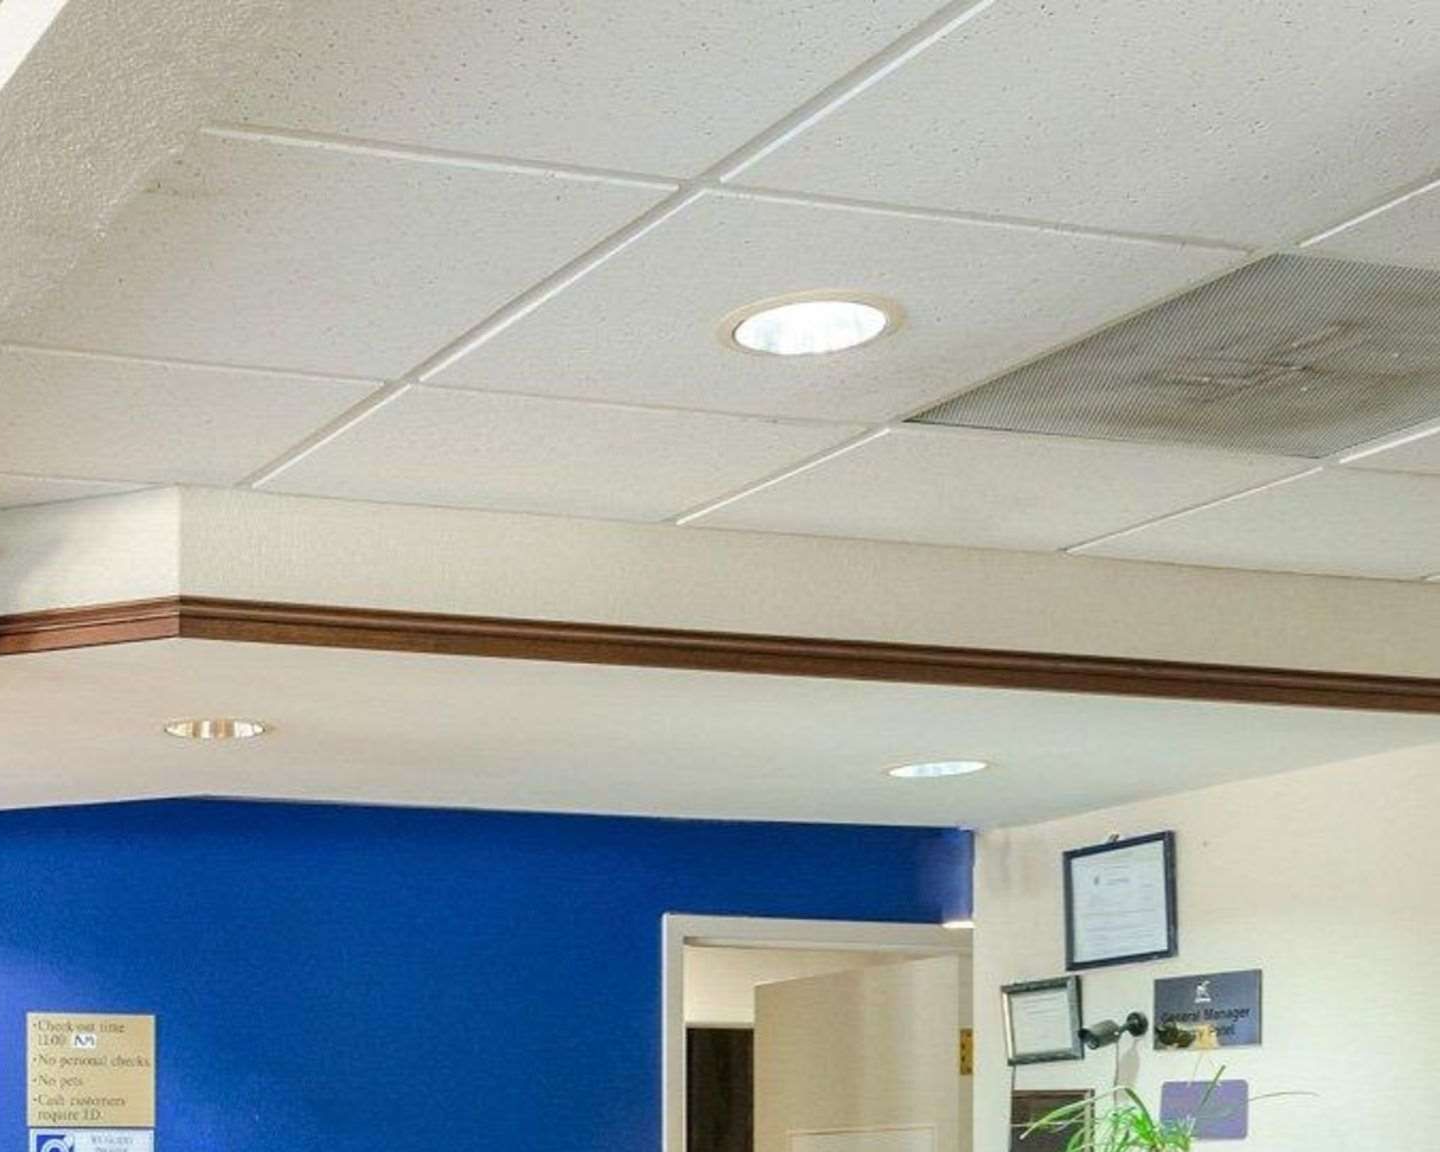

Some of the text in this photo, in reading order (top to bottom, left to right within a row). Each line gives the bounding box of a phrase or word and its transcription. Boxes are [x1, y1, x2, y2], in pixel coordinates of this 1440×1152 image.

[1203, 1005, 1250, 1022] Manager
[39, 1055, 57, 1066] No
[39, 1075, 57, 1086] No
